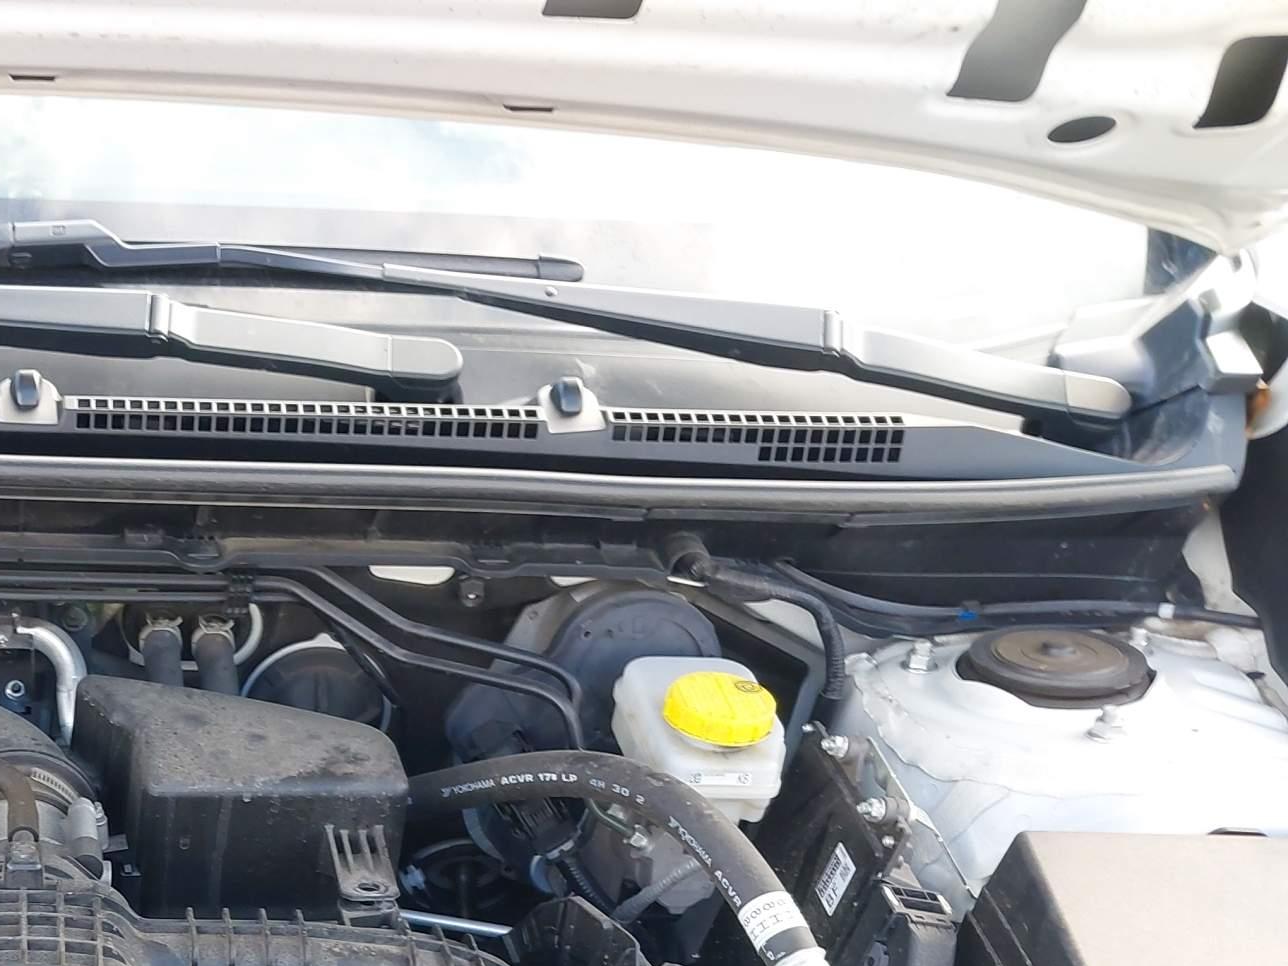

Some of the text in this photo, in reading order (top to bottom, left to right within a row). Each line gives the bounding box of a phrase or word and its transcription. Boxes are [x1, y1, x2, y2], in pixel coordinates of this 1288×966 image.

[500, 773, 535, 785] ACVR
[561, 772, 579, 784] LP
[611, 784, 630, 797] 30
[714, 869, 743, 908] ACVR
